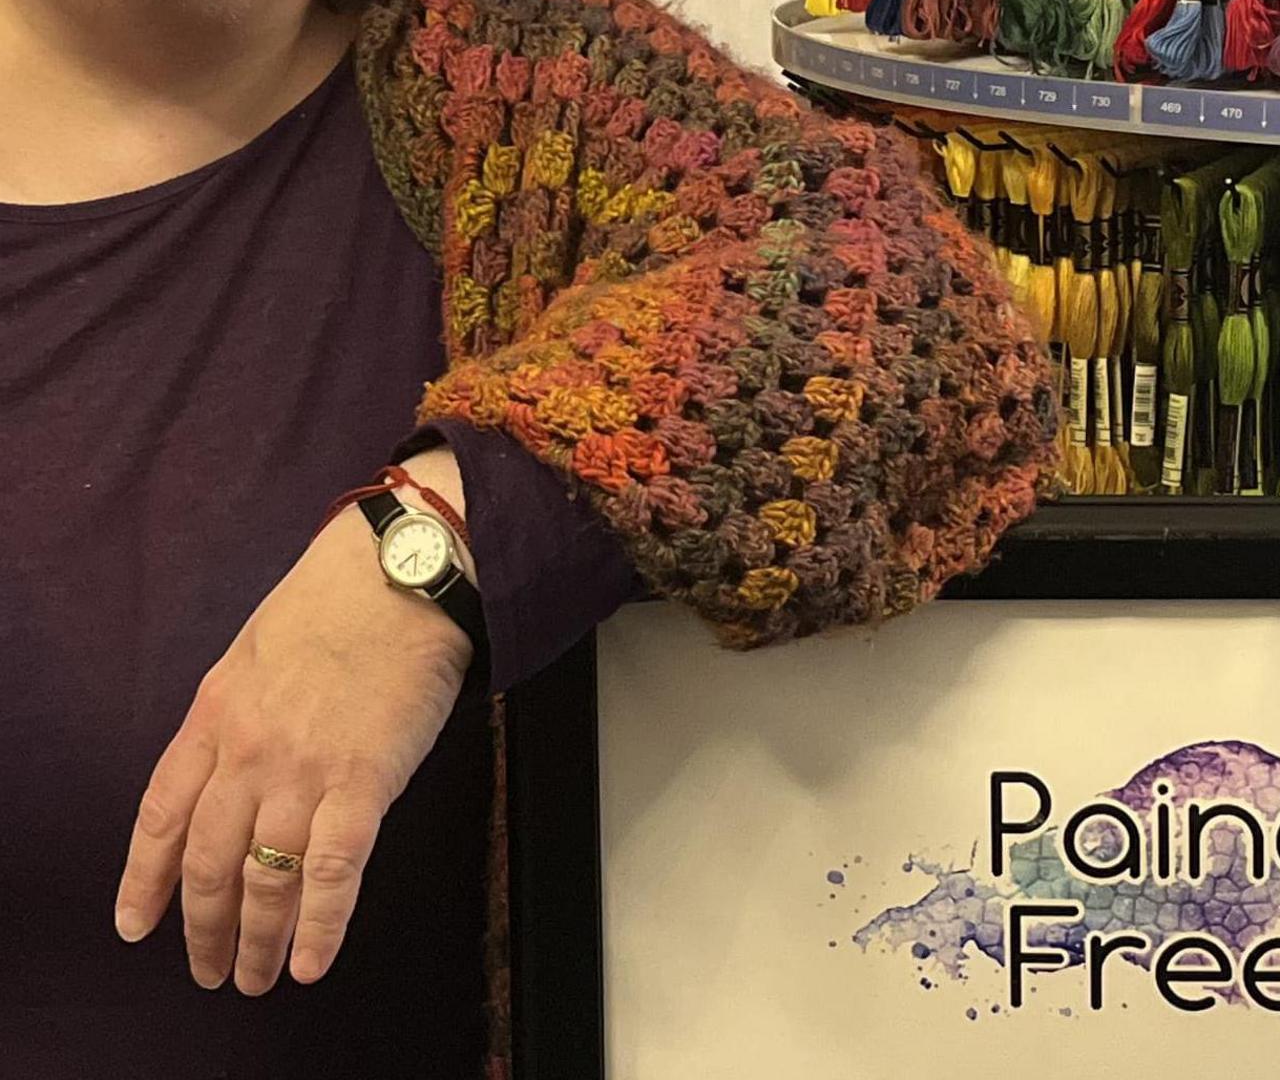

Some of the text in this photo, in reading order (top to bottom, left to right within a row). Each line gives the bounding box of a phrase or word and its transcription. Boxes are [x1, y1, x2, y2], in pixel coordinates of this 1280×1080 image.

[945, 79, 961, 91] 727
[1038, 90, 1057, 102] 729
[1091, 95, 1111, 108] 730
[1160, 101, 1182, 114] 469
[1220, 107, 1243, 119] 470
